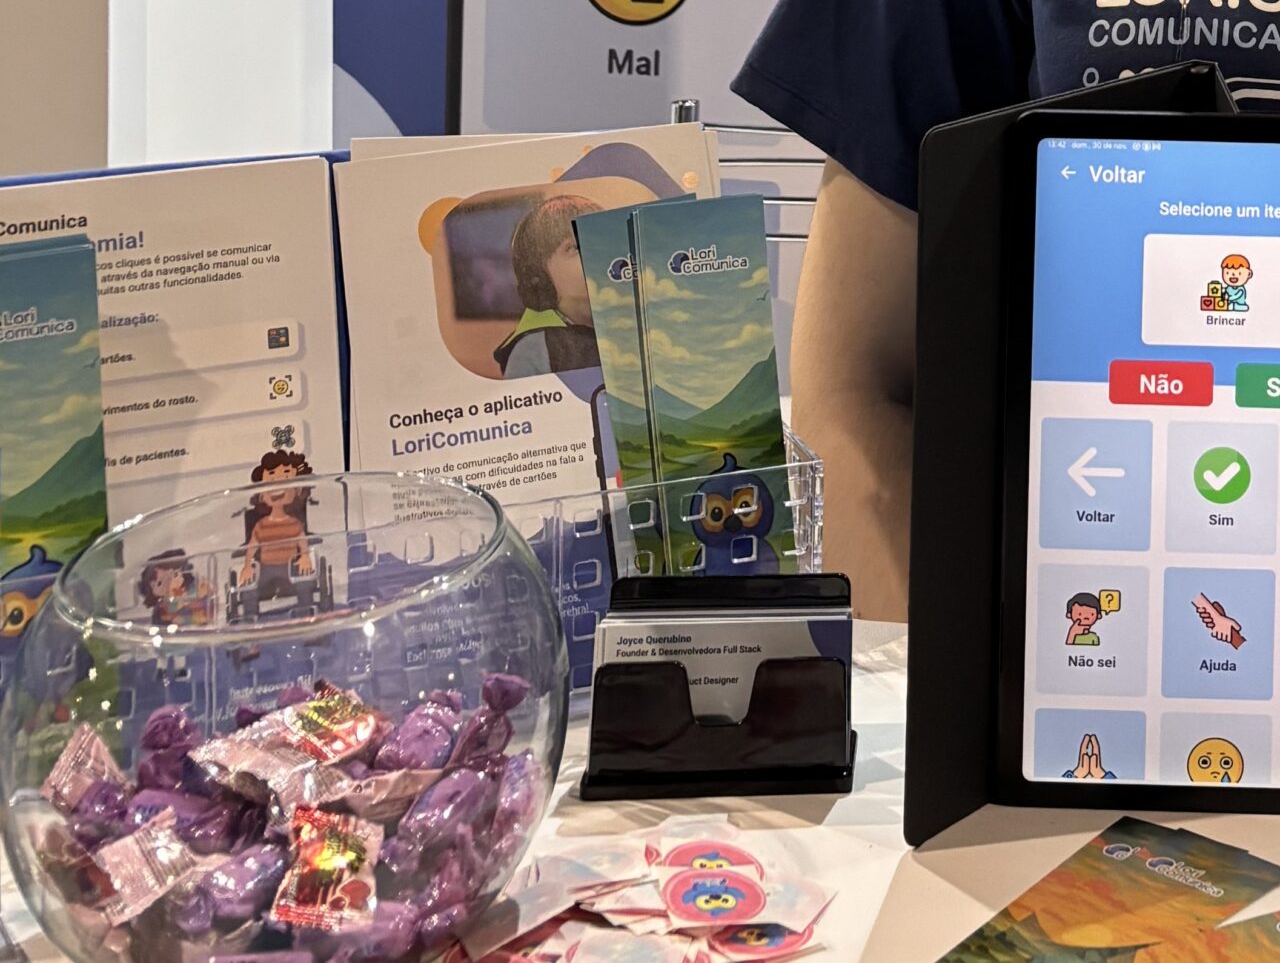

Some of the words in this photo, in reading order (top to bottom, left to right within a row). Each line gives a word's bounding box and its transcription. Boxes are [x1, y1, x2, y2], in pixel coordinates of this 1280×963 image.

[606, 49, 662, 78] Mal
[1089, 165, 1146, 184] Voltar
[1159, 201, 1233, 218] Selecione
[1236, 206, 1260, 218] um
[97, 231, 145, 253] mia!
[690, 246, 717, 261] Lori
[101, 269, 138, 283] através
[140, 268, 154, 279] da
[155, 262, 210, 278] navegação
[212, 257, 249, 271] manual
[251, 257, 264, 266] ou
[265, 254, 281, 264] via
[683, 256, 748, 275] Comunica
[98, 285, 126, 297] uitas
[127, 281, 161, 293] outras
[162, 271, 242, 289] funcionalidades.
[3, 307, 38, 328] Lori
[100, 312, 160, 330] alização:
[1206, 314, 1246, 326] Brincar
[100, 352, 135, 366] artões.
[1139, 373, 1184, 395] Não
[102, 401, 151, 416] vimentos
[389, 407, 464, 429] Conheça
[468, 404, 479, 416] o
[483, 390, 563, 416] aplicativo
[391, 419, 533, 457] LoriComunica
[442, 462, 455, 473] de
[456, 452, 519, 471] comunicação
[521, 444, 569, 460] alternativa
[570, 441, 587, 453] que
[509, 476, 521, 487] de
[522, 471, 558, 484] cartões
[1076, 509, 1116, 523] Voltar
[1208, 513, 1234, 526] Sim
[616, 636, 644, 648] Joyce
[645, 634, 692, 646] Querubino
[615, 648, 649, 658] Founder
[650, 647, 657, 657] &
[657, 646, 722, 657] Desenvolvedora
[722, 645, 738, 654] Full
[739, 644, 762, 654] Stack
[1068, 655, 1094, 668] Não
[1097, 656, 1116, 669] sei
[1199, 659, 1237, 674] Ajuda
[703, 676, 739, 687] Designer
